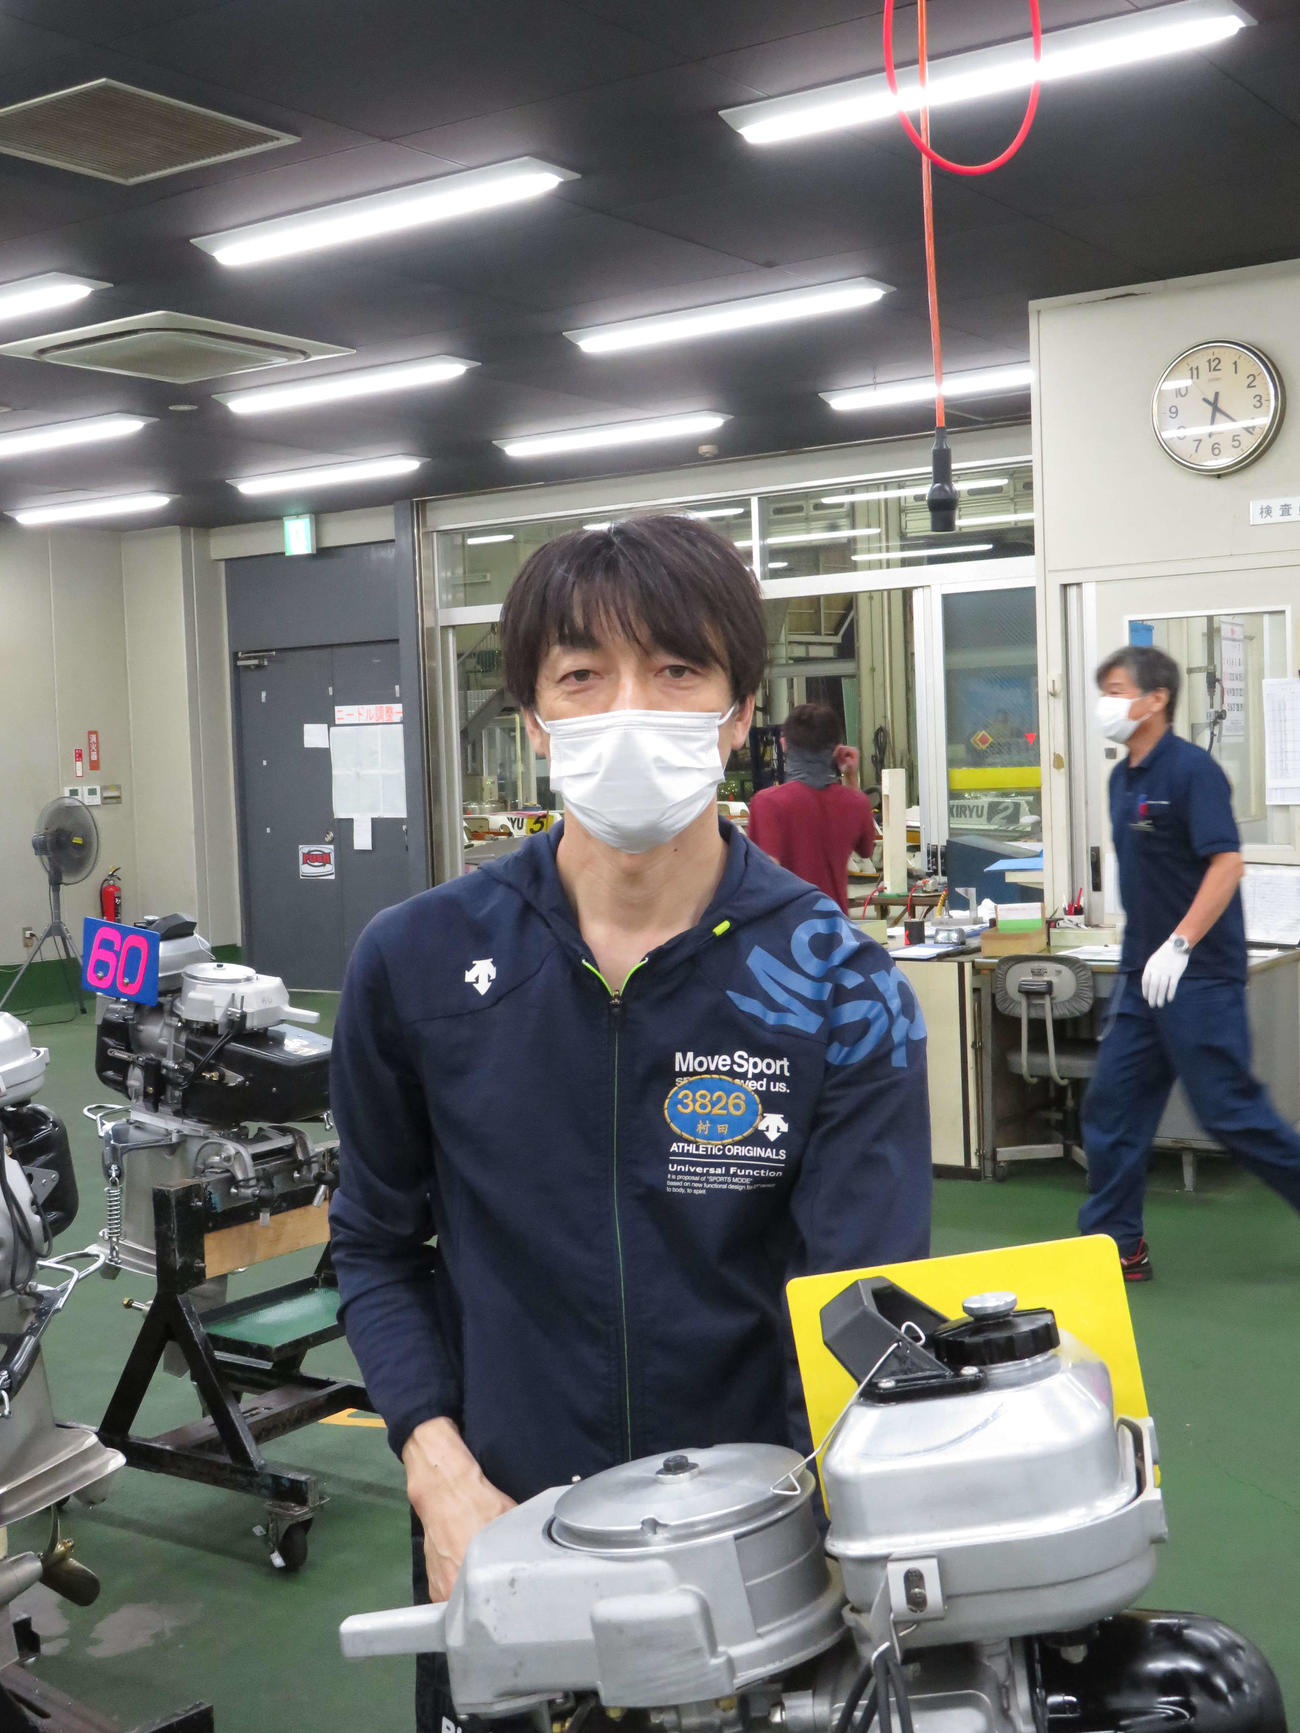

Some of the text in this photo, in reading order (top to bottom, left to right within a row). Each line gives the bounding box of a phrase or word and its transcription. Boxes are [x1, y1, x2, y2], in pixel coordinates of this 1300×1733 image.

[1207, 357, 1222, 373] 12
[1232, 360, 1238, 374] 1
[1189, 366, 1199, 380] 11
[1246, 374, 1256, 389] 2
[1253, 394, 1263, 409] 3
[1168, 405, 1179, 419] 9
[1193, 439, 1202, 453] 7
[1232, 434, 1241, 449] 5
[1211, 442, 1221, 457] 6
[1259, 503, 1300, 519] 検査
[990, 801, 1015, 825] 2
[529, 815, 547, 834] 5
[87, 926, 149, 996] 60
[770, 1081, 790, 1093] us.
[677, 1090, 747, 1116] 3826
[670, 1142, 787, 1160] ATHLETIC ORIGINALS
[668, 1163, 783, 1177] Universal Function
